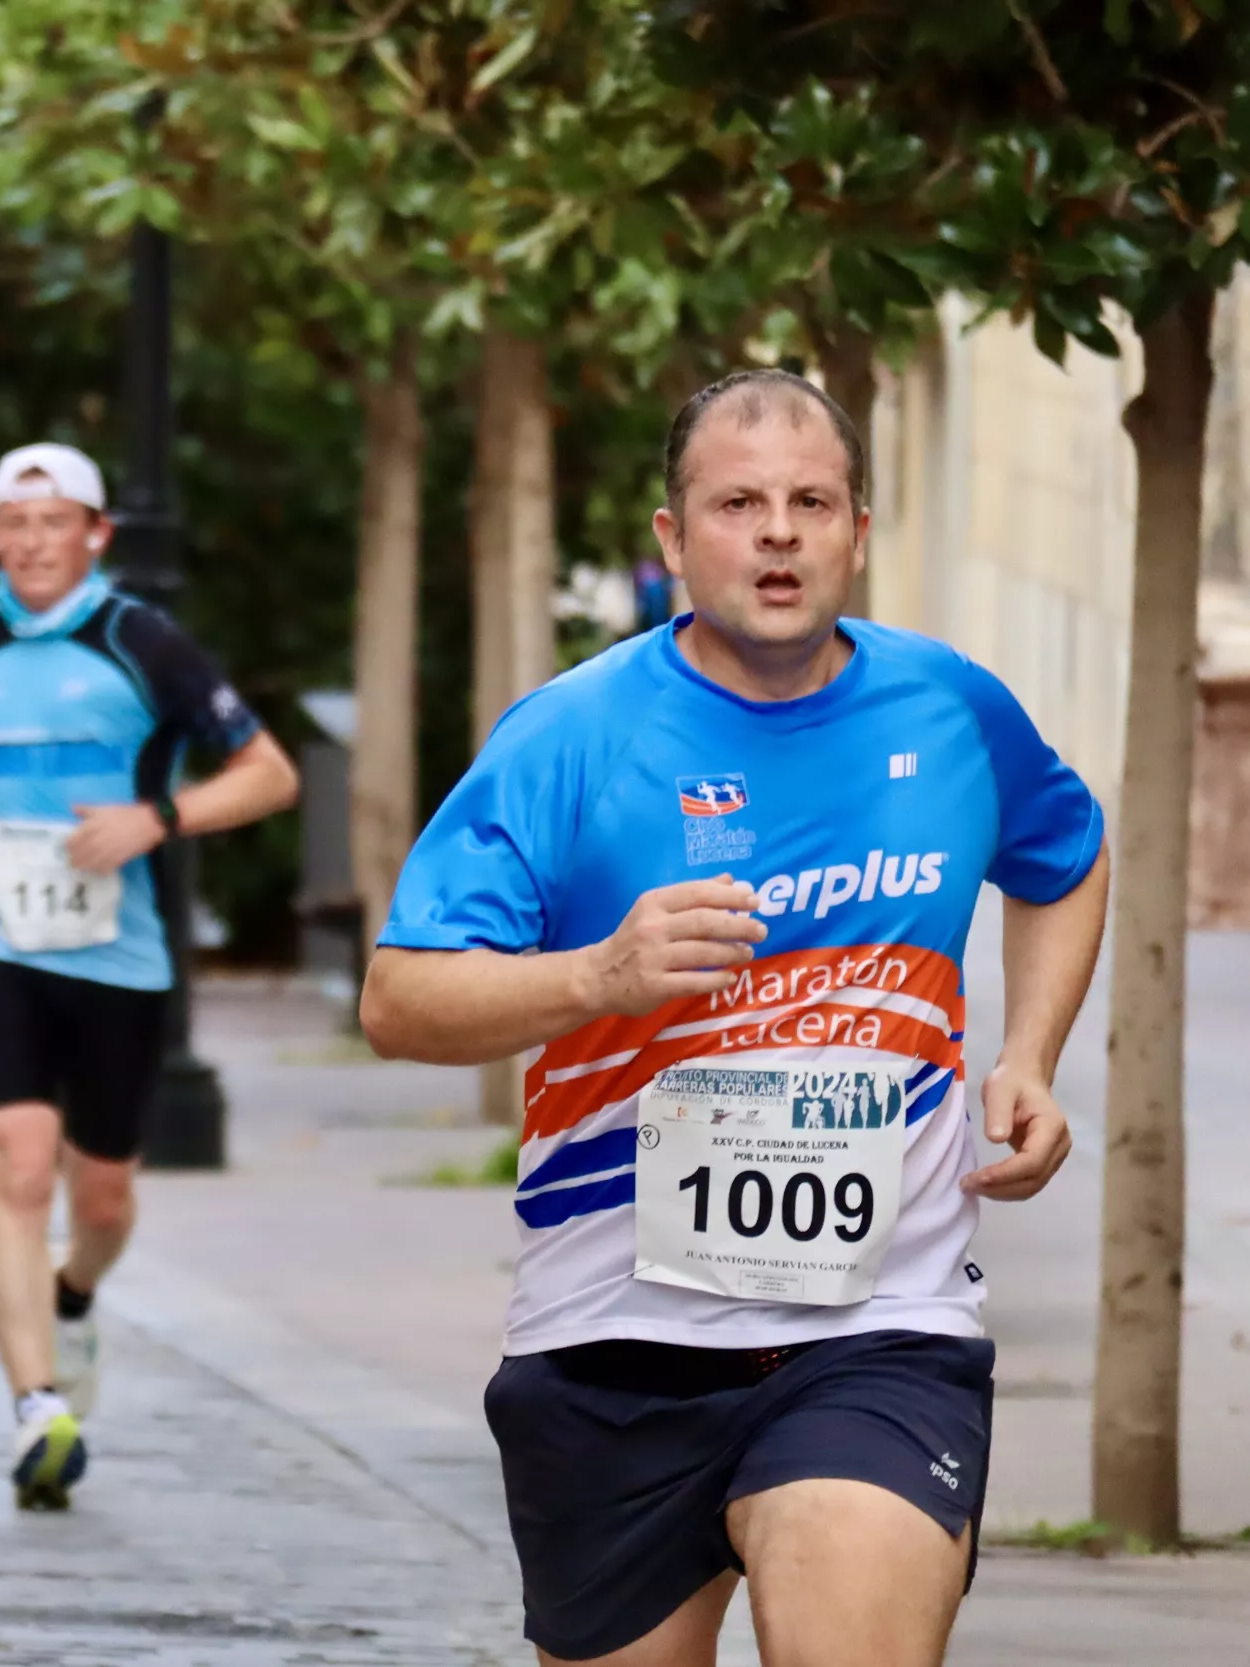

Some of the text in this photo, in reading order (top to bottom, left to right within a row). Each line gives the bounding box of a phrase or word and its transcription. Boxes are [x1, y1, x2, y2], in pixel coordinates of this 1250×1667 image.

[732, 849, 945, 919] erplus
[14, 881, 89, 917] 114
[710, 947, 907, 1011] Maratón
[705, 1070, 771, 1084] PROVINCIAL
[775, 1072, 789, 1084] DE
[718, 1082, 789, 1096] POPULARES
[793, 1071, 858, 1099] 2024
[711, 1137, 849, 1150] XXV C.P. CIUDAD DE LUCENA
[733, 1152, 824, 1164] POR LA IGUALDAD
[678, 1166, 874, 1243] 1009
[685, 1250, 712, 1261] JUAN
[713, 1255, 766, 1267] ANTONIO
[768, 1259, 815, 1271] SERVIAN
[930, 1461, 959, 1490] ipso
